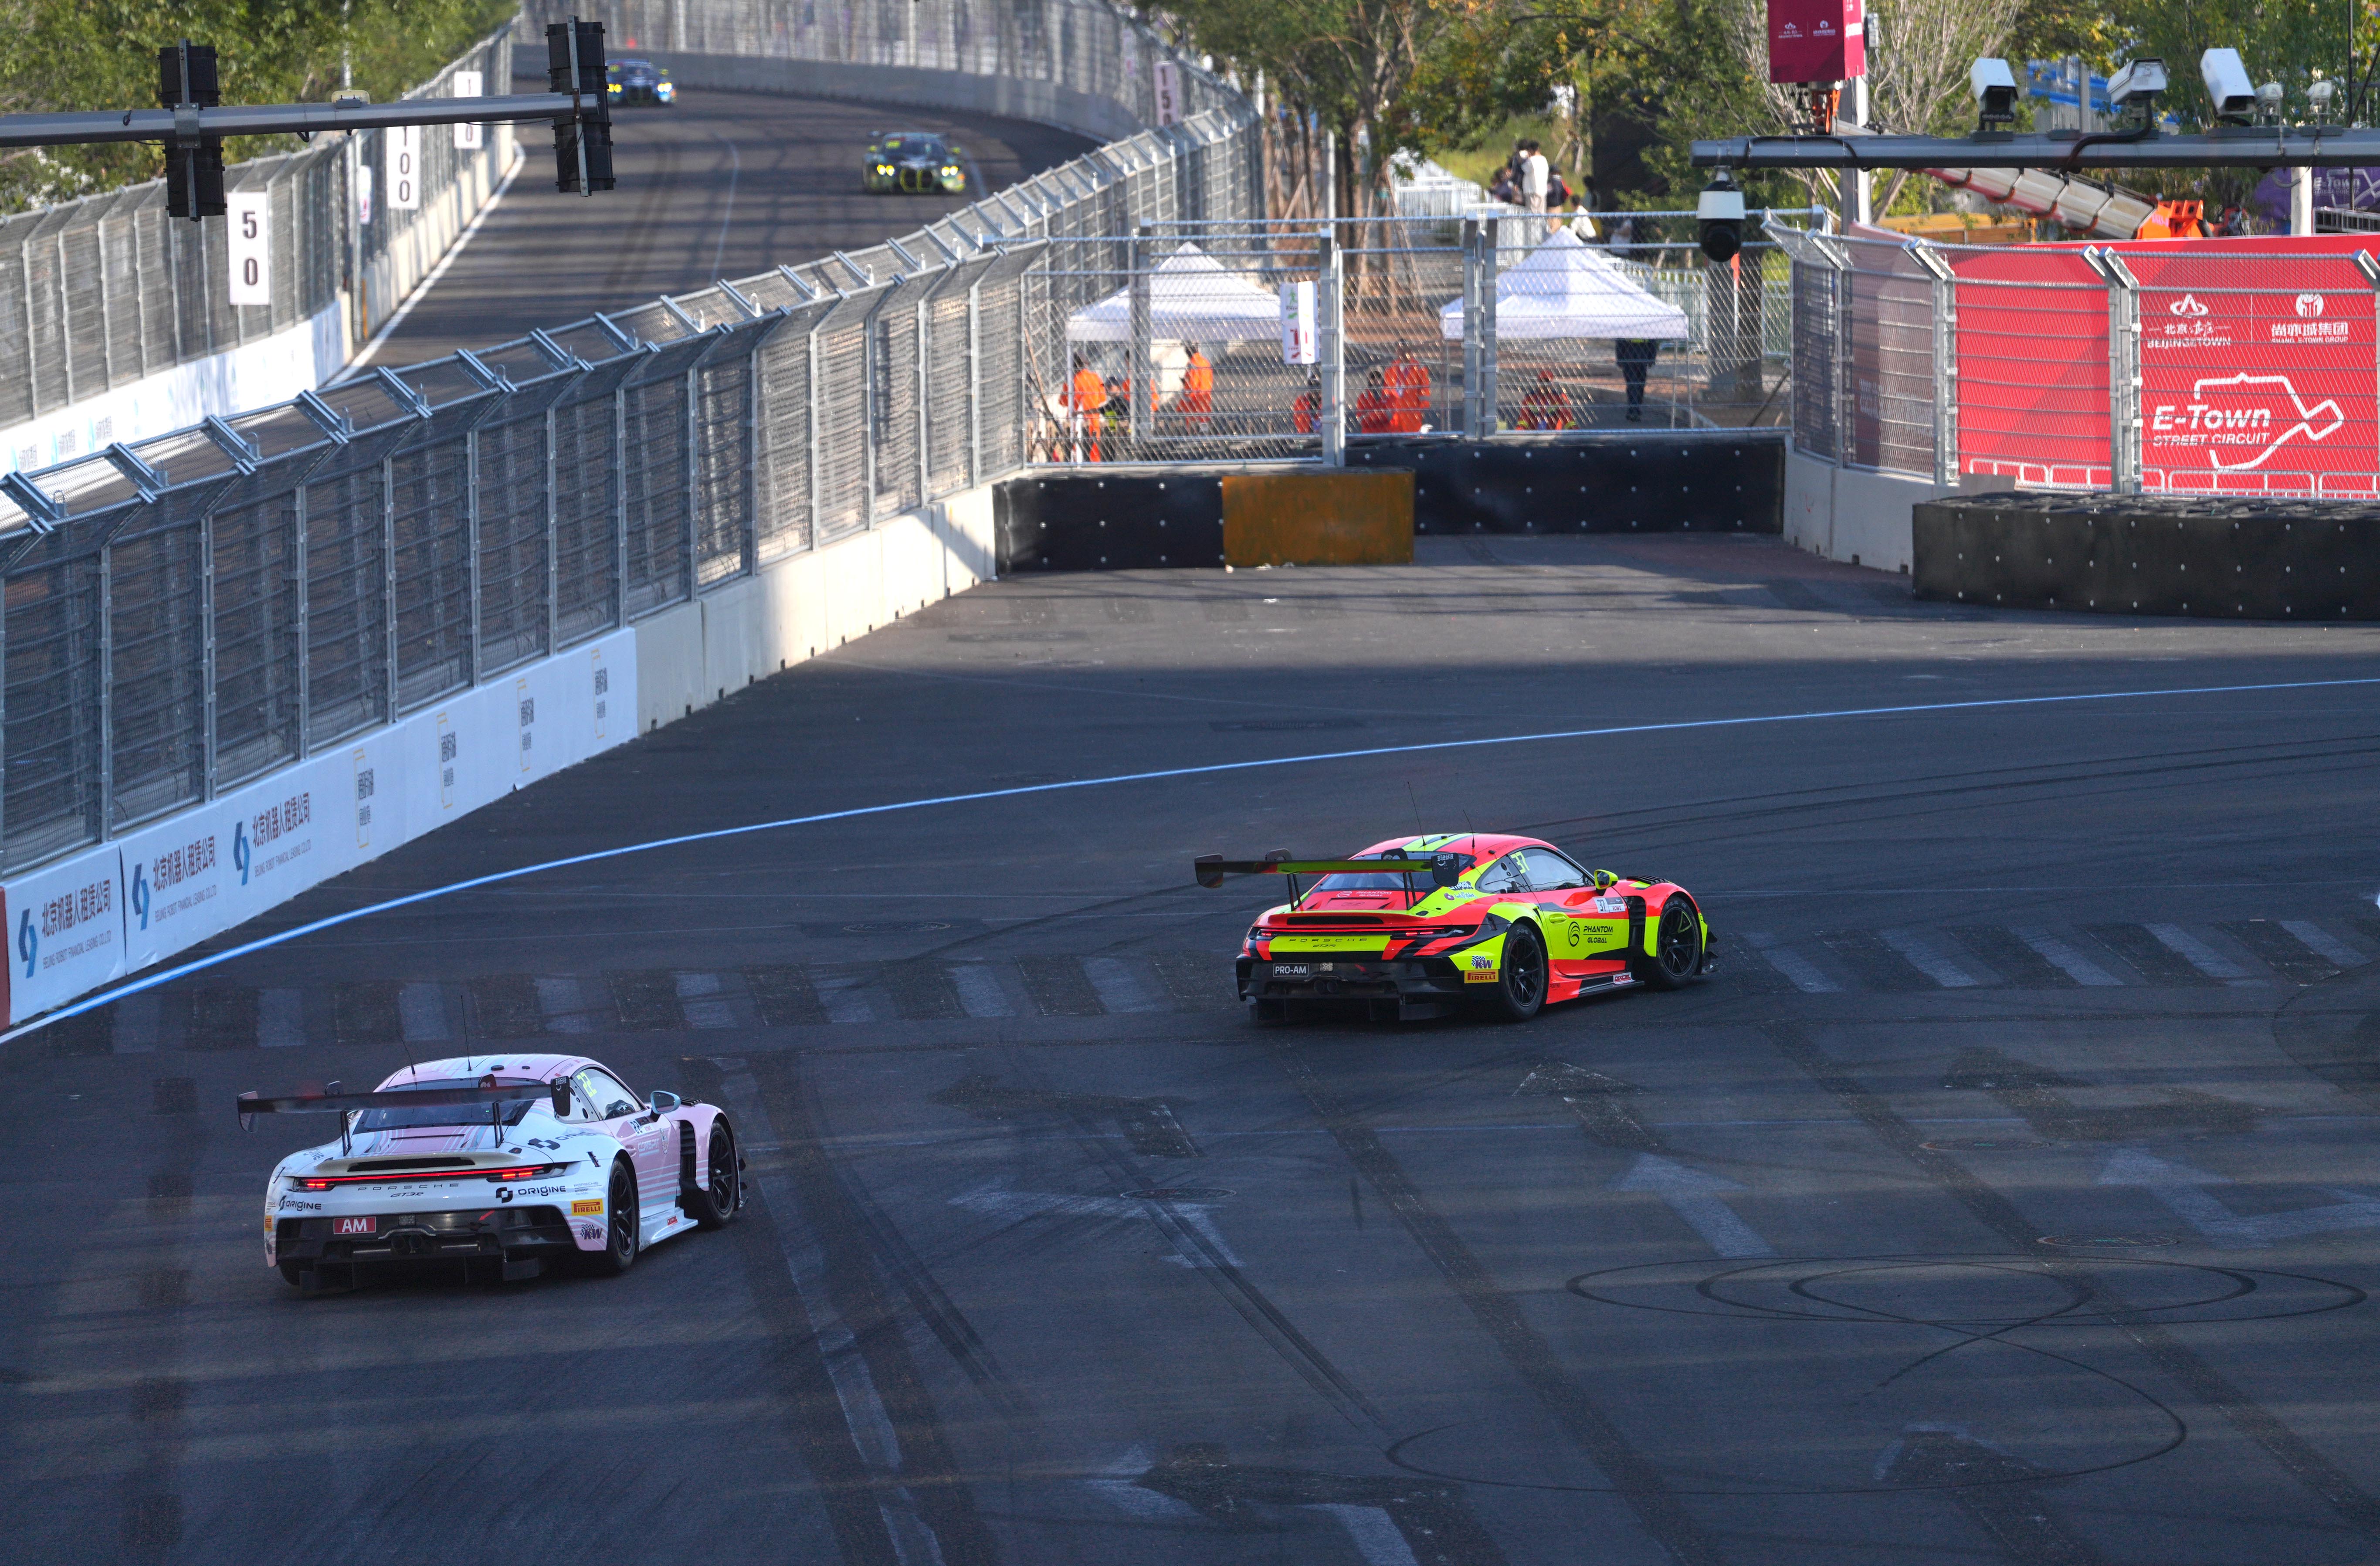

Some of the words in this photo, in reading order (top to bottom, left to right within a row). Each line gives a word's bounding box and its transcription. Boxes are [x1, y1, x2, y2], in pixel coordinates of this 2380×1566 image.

[465, 79, 474, 142] 10
[399, 126, 410, 202] 100
[242, 210, 258, 286] 50
[2153, 404, 2271, 430] E-Town
[2153, 434, 2208, 447] STREET
[2211, 432, 2270, 445] CIRCUIT
[252, 792, 310, 848] 北京机器人租赁公司
[153, 835, 215, 892] 北京机器人租赁公司
[1510, 851, 1530, 874] 37
[42, 878, 110, 938] 北京机器人租赁公司
[1597, 899, 1606, 912] 37
[1275, 966, 1307, 974] PRO-AM
[1475, 959, 1493, 969] KW
[1467, 971, 1496, 981] PIRELLI
[576, 1072, 597, 1098] 22
[630, 1121, 643, 1134] 22
[357, 1183, 459, 1191] PORSCHE
[573, 1201, 600, 1213] PIRELLI
[342, 1218, 367, 1233] AM
[583, 1227, 603, 1240] KW
